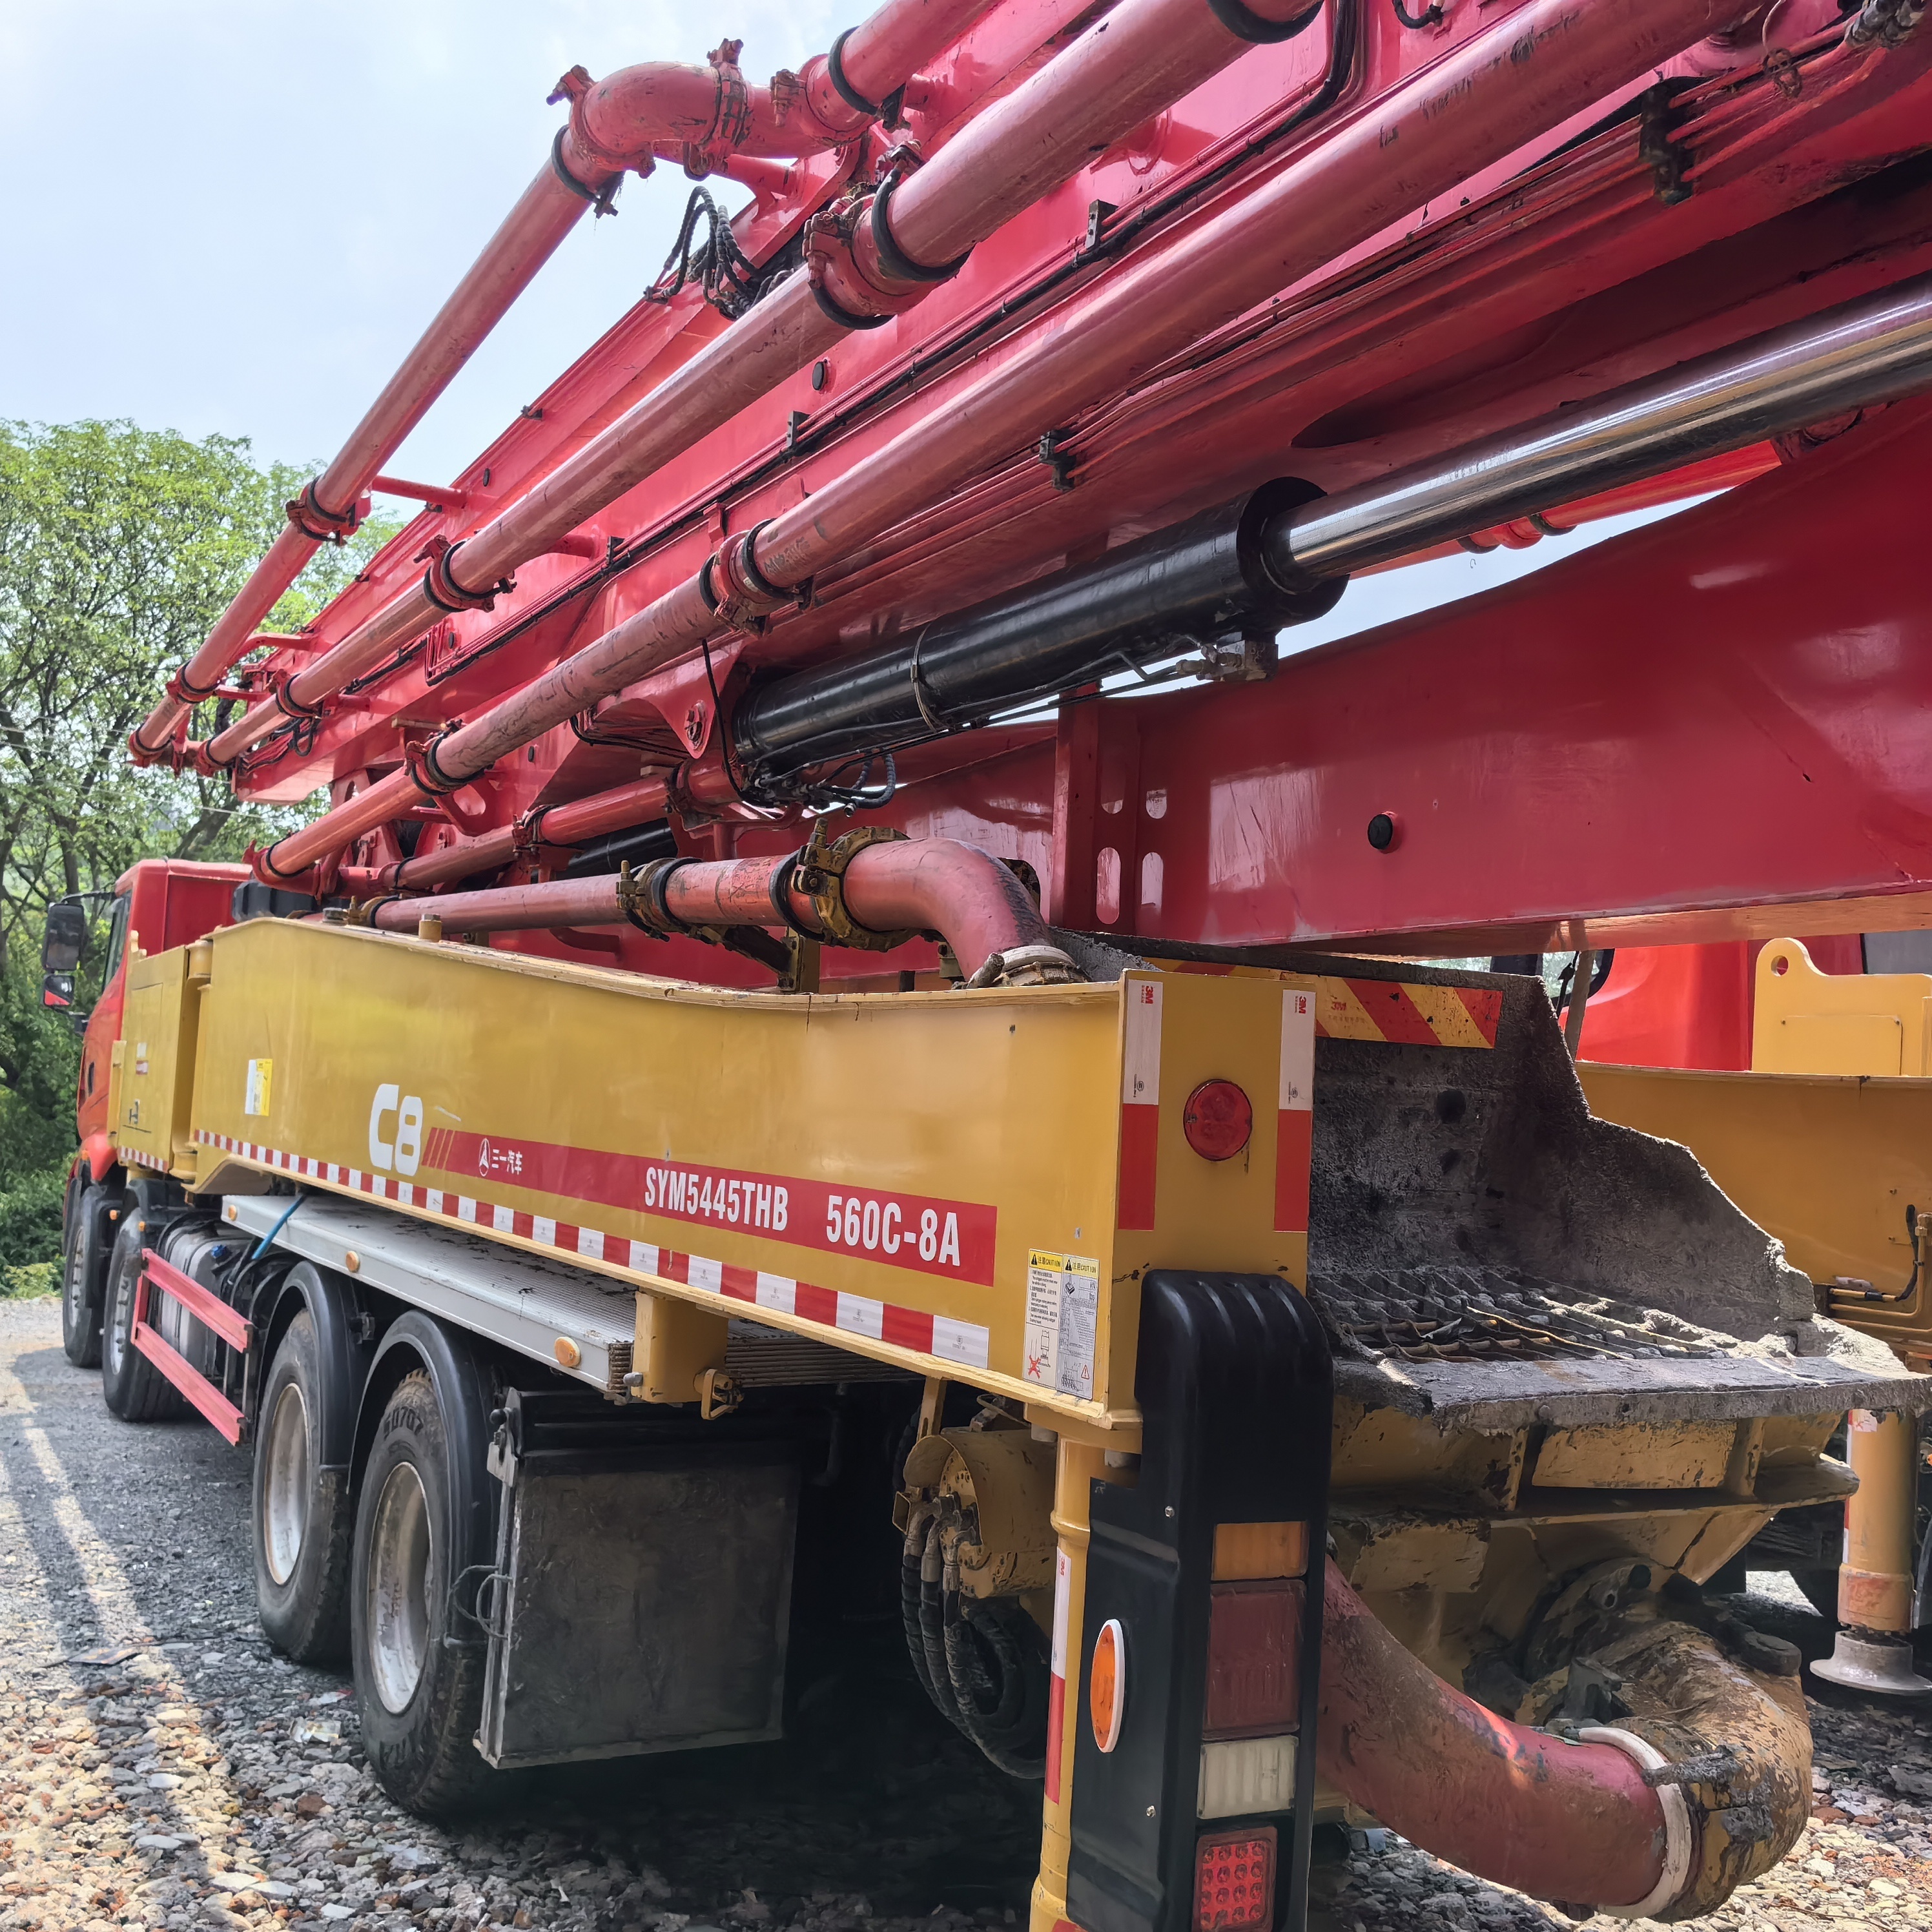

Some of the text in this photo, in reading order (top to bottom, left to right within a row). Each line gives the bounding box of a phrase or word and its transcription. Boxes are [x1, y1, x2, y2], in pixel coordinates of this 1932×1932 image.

[1146, 985, 1154, 1004] 3M
[1299, 996, 1307, 1014] 3M
[1331, 1001, 1347, 1011] 3M
[369, 1084, 423, 1177] C8
[491, 1149, 523, 1175] 三一汽车
[645, 1167, 960, 1266] SYM5445THB 560C-8A
